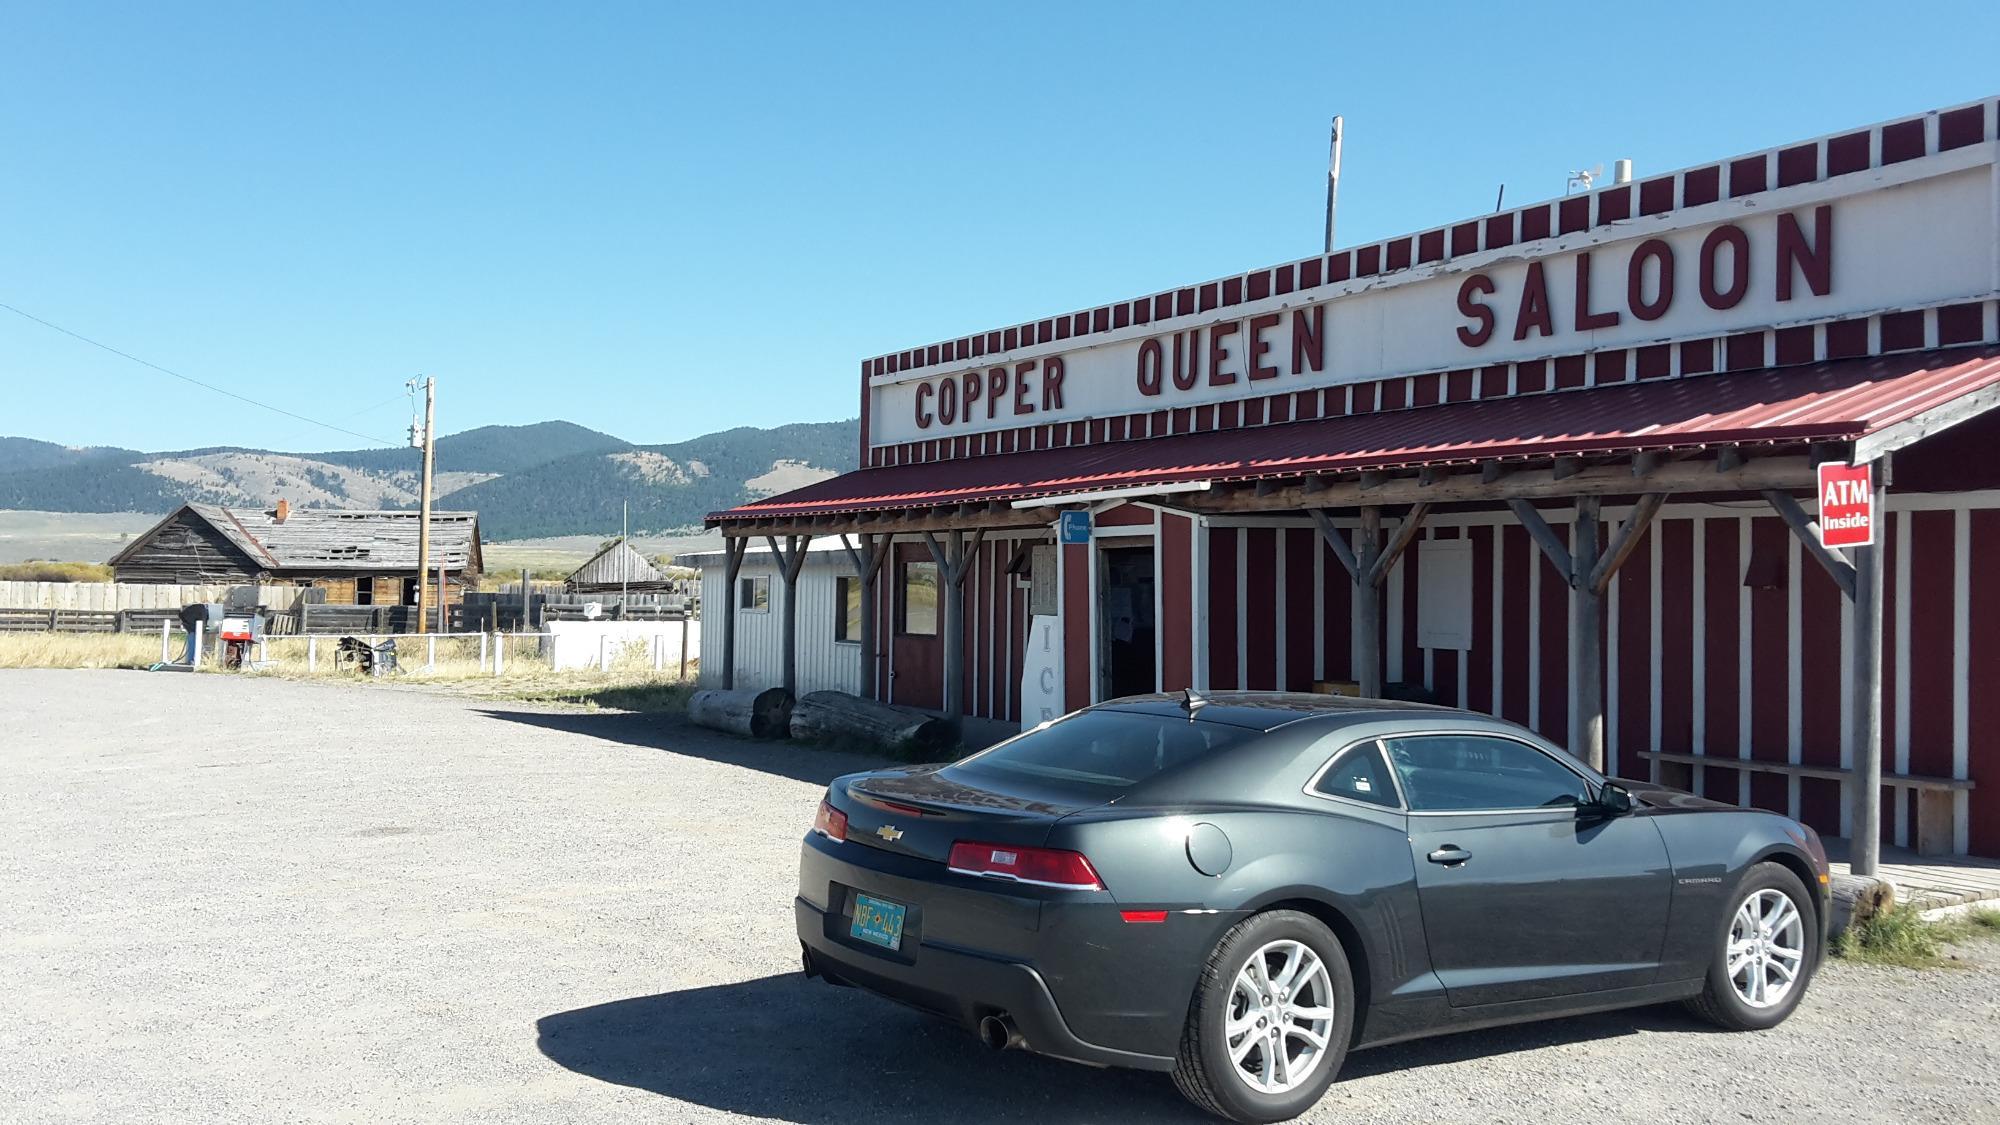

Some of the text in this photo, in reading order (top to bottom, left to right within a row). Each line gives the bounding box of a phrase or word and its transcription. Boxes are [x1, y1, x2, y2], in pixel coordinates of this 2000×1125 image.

[914, 205, 1831, 429] COPPER QUEEN SALOON
[1823, 479, 1869, 507] ATM
[1823, 512, 1869, 530] Inside
